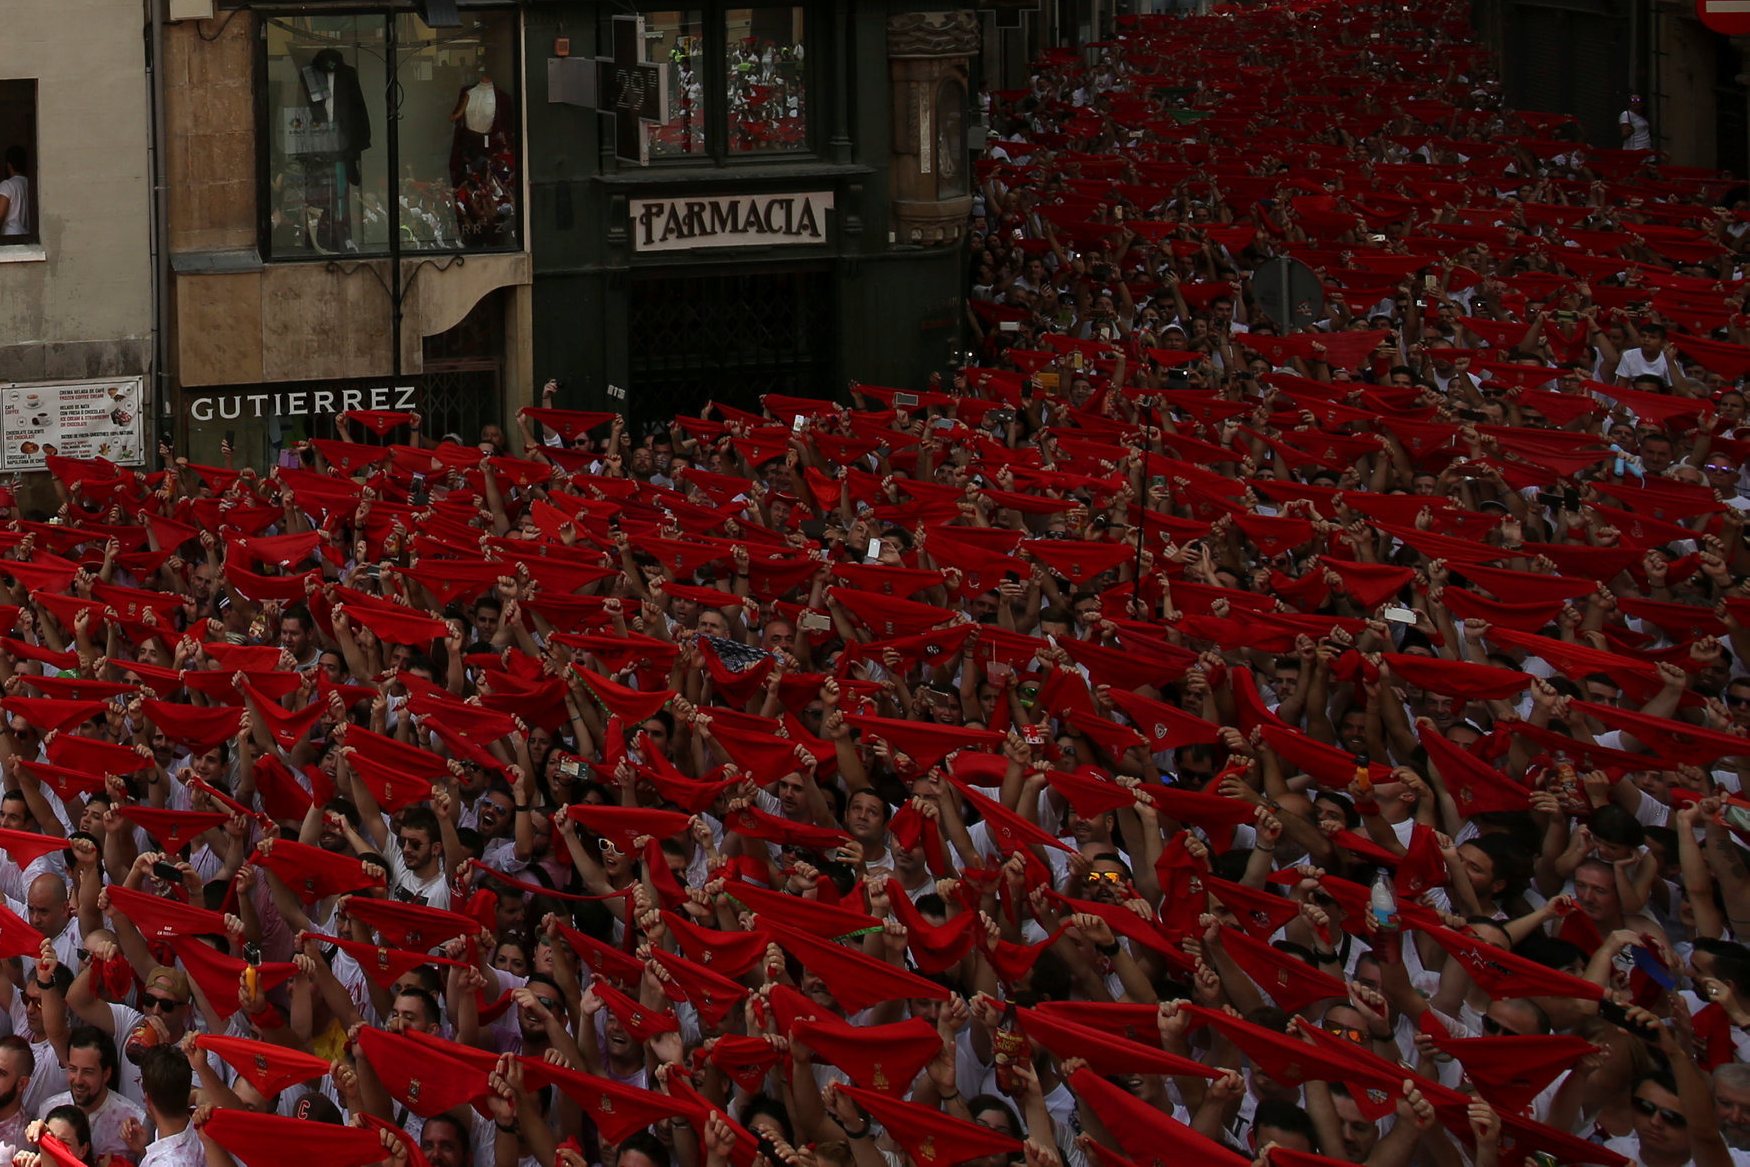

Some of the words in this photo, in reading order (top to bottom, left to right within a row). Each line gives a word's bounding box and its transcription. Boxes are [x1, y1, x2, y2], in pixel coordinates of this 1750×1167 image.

[640, 197, 822, 245] FARMACIA
[190, 386, 416, 421] GUTIERREZ
[297, 1099, 311, 1120] C
